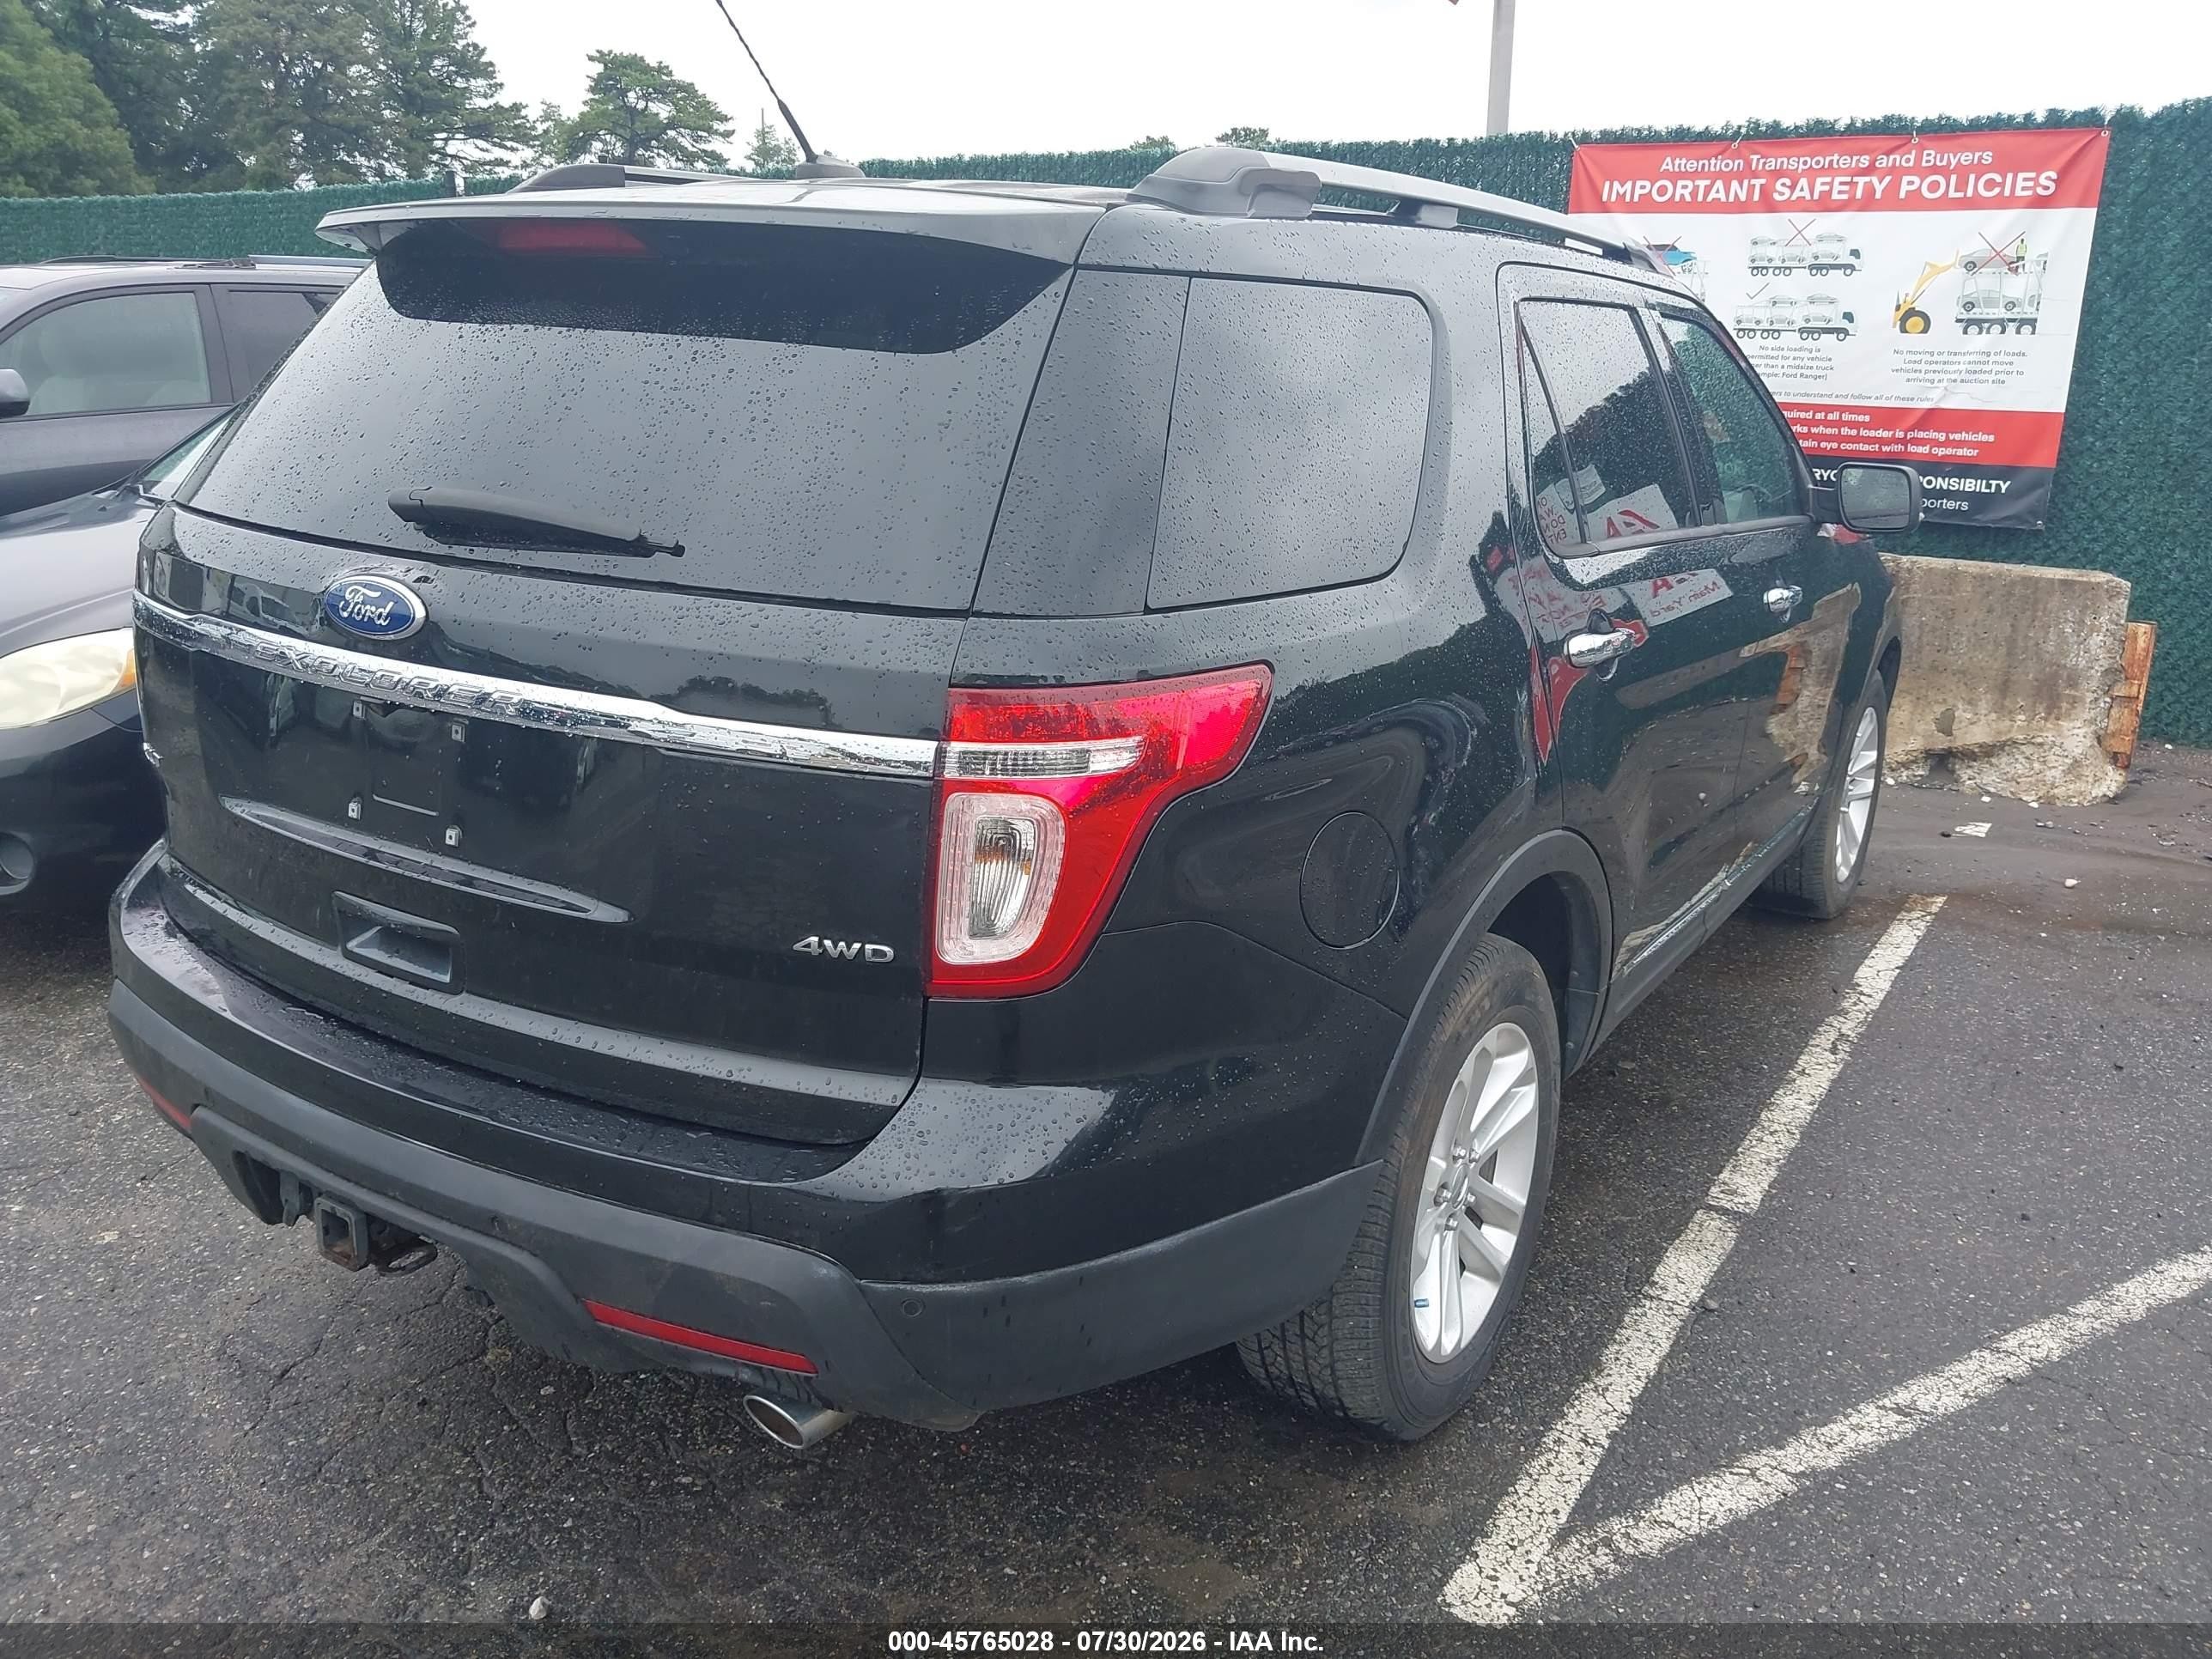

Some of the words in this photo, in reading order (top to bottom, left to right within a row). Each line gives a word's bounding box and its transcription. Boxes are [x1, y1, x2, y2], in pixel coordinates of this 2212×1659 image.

[1660, 155, 1744, 173] Attention
[1749, 152, 1869, 173] Transporters
[1875, 149, 1916, 168] and
[1921, 149, 1993, 170] Buyers
[1601, 179, 1765, 203] IMPORTANT
[1772, 175, 1892, 201] SAFETY
[1899, 171, 2058, 200] POLICIES
[1786, 345, 1813, 354] loading
[1905, 349, 1935, 358] moving
[1947, 349, 1991, 358] transferring
[1924, 359, 1961, 368] operators
[1924, 368, 1963, 376] previously
[1905, 376, 1935, 385] arriving
[1792, 391, 1833, 399] understand
[1884, 393, 1893, 402] of
[1827, 411, 1839, 421] all
[1842, 411, 1870, 422] times
[1791, 424, 1808, 434] rks
[1810, 425, 1838, 435] when
[1840, 426, 1857, 436] the
[1859, 427, 1894, 439] loader
[1895, 428, 1905, 439] is
[1907, 429, 1946, 442] placing
[1948, 431, 1995, 443] vehicles
[1799, 439, 1818, 448] tain
[1820, 441, 1838, 451] eye
[1840, 441, 1880, 452] contact
[1881, 442, 1905, 453] with
[1907, 443, 1929, 454] load
[1931, 446, 1979, 458] operator
[1919, 475, 2011, 495] ONSIBILTY
[338, 583, 396, 629] Ford
[252, 640, 523, 716] EXPLORER
[792, 935, 895, 964] 4WD
